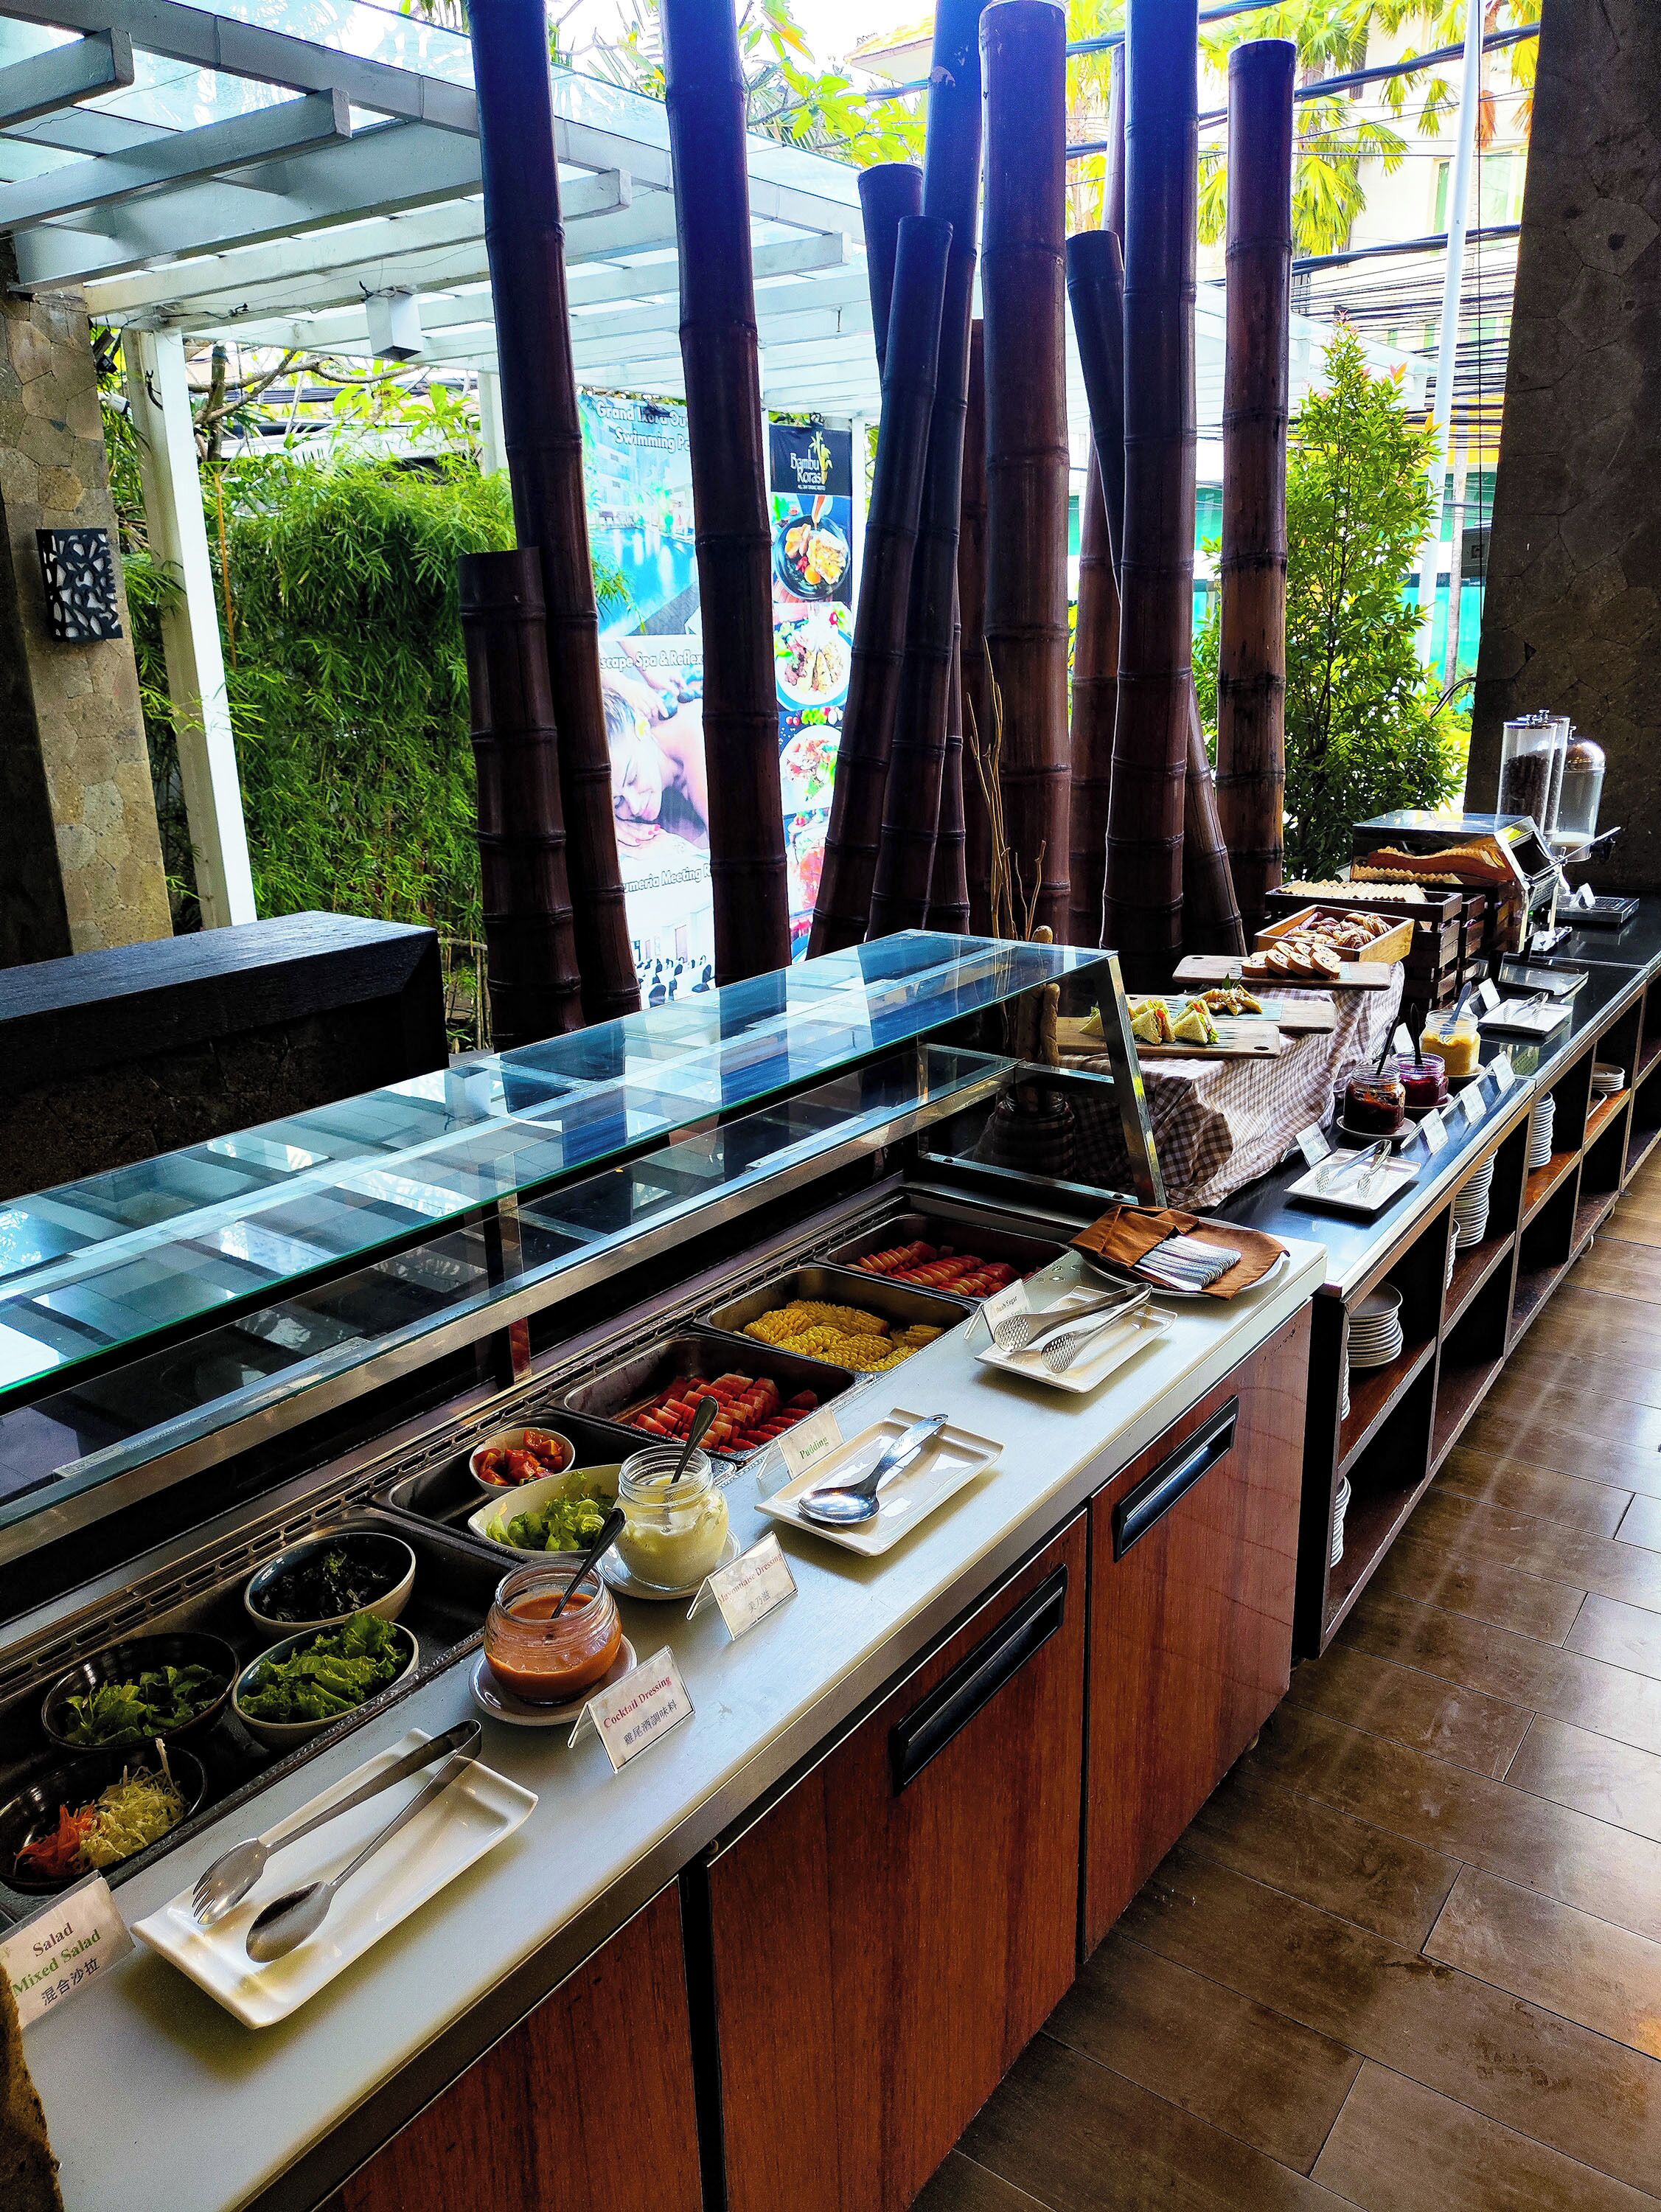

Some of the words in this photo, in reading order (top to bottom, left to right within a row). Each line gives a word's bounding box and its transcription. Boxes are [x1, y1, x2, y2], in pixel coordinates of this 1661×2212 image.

[596, 399, 634, 422] Grand
[615, 426, 676, 453] Swimming
[790, 448, 820, 471] Bambu
[599, 655, 634, 672] scape
[635, 651, 657, 672] Spa
[659, 650, 669, 667] &
[669, 649, 703, 666] Reflex
[661, 866, 701, 886] Meeting
[799, 1436, 829, 1459] Pudding
[717, 1571, 756, 1604] Mayonnaise
[754, 1552, 783, 1576] Dressing
[603, 1697, 639, 1730] Cocktail
[638, 1675, 672, 1705] Dressing
[32, 1921, 75, 1958] Salad
[11, 1956, 60, 1997] Mixed
[60, 1927, 102, 1964] Salad
[41, 1956, 101, 2006] 混合沙拉
